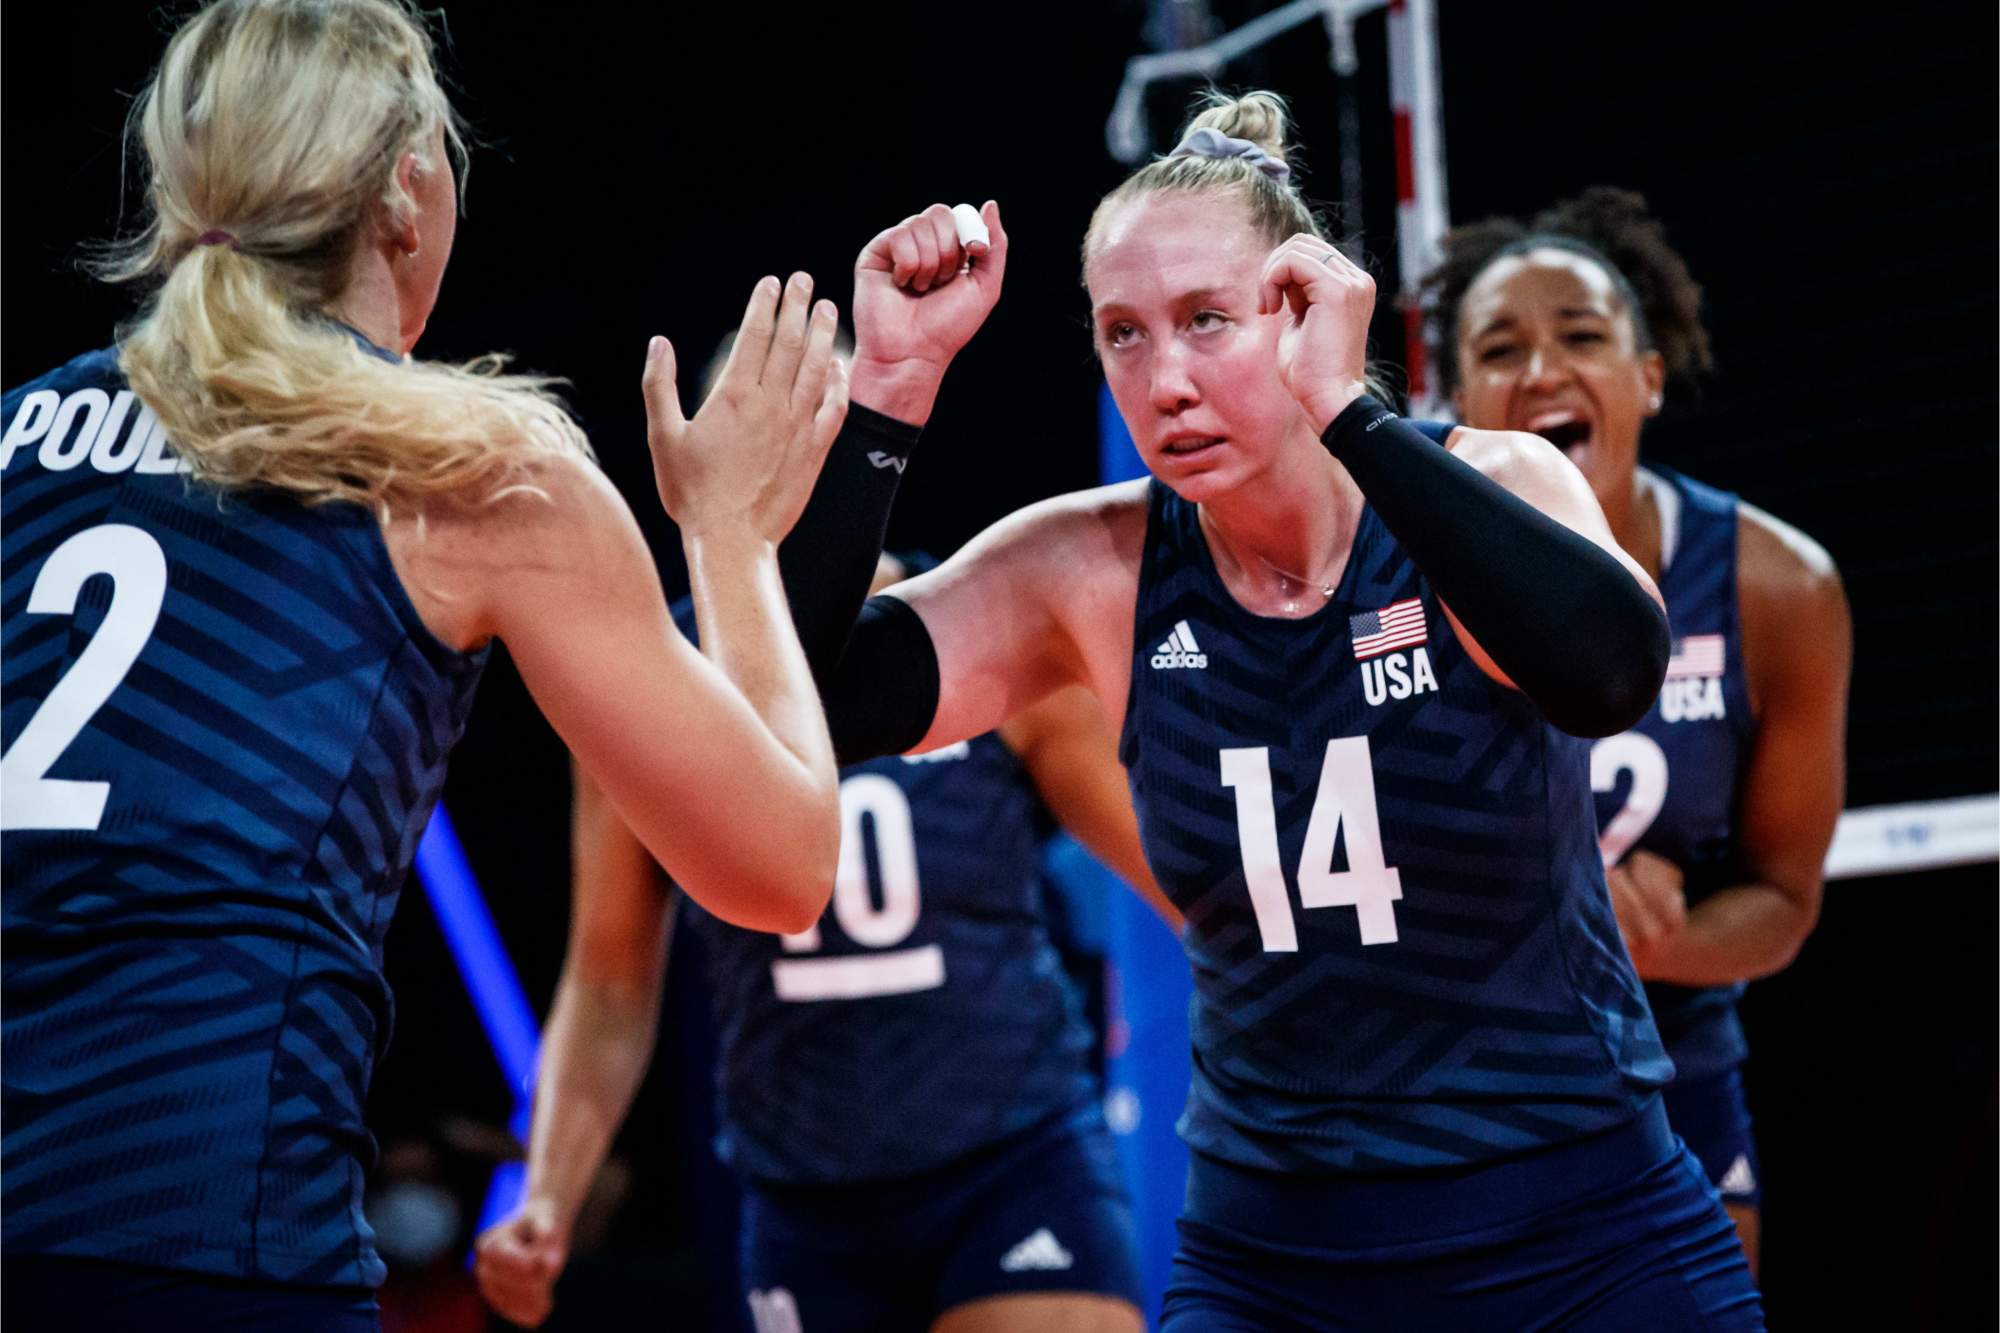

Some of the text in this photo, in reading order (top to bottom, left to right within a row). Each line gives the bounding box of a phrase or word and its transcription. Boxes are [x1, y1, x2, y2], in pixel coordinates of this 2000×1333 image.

[1, 388, 193, 474] POUL
[1, 523, 168, 831] 2
[1151, 651, 1208, 669] adidas
[1360, 647, 1439, 706] USA
[1659, 677, 1726, 723] USA
[780, 773, 921, 952] 0
[1219, 735, 1403, 952] 14
